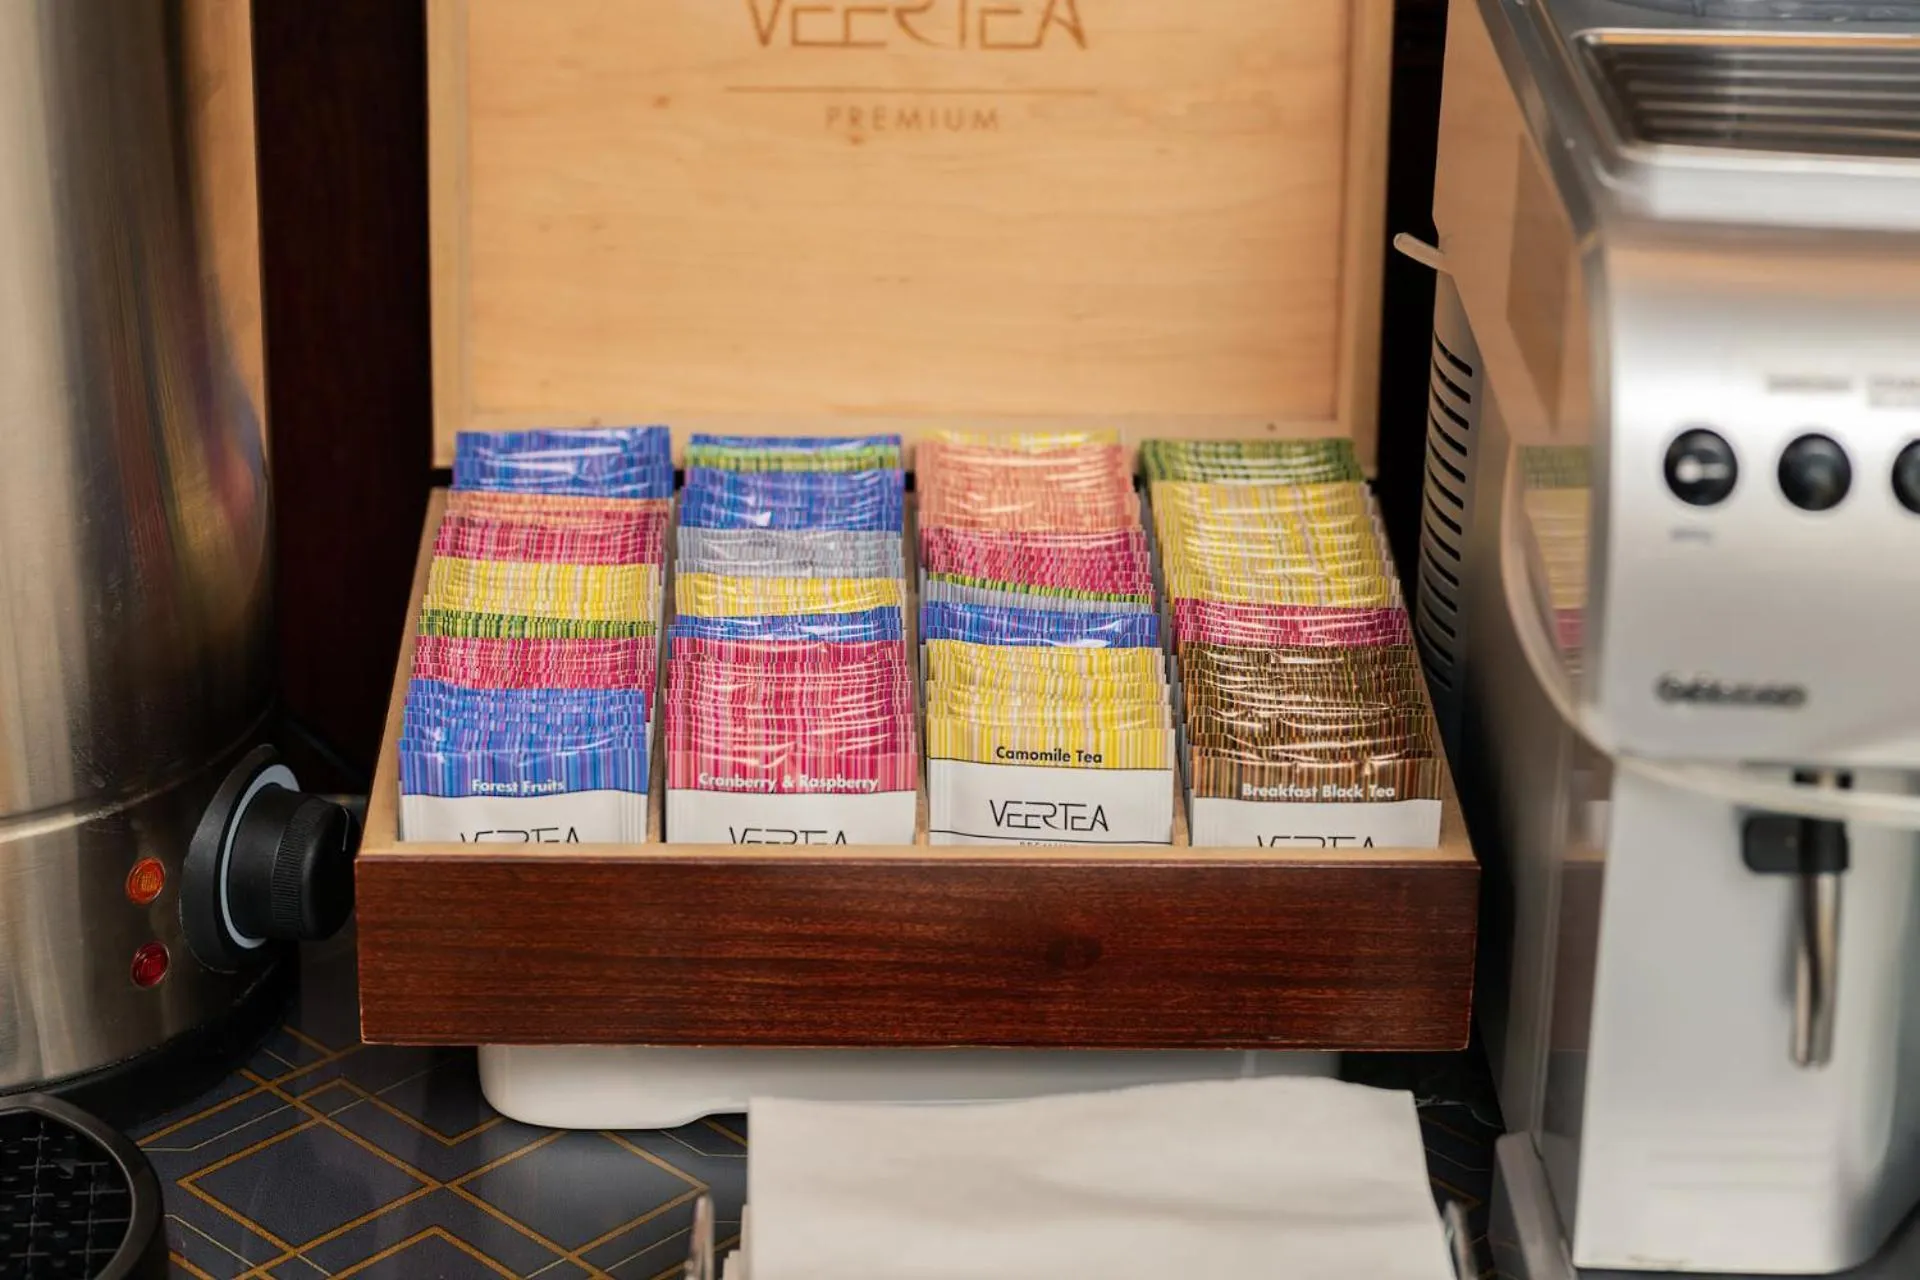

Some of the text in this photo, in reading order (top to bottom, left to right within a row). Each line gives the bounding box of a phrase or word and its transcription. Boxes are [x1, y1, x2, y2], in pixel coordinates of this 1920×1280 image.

[825, 106, 999, 132] PREMIUM
[996, 746, 1103, 763] Camomile Tea
[471, 779, 566, 792] Forest Fruits
[699, 772, 879, 793] Cranberry & Raspberry
[1242, 783, 1396, 798] Breakfast Black Tea
[989, 799, 1110, 832] VEERTEA
